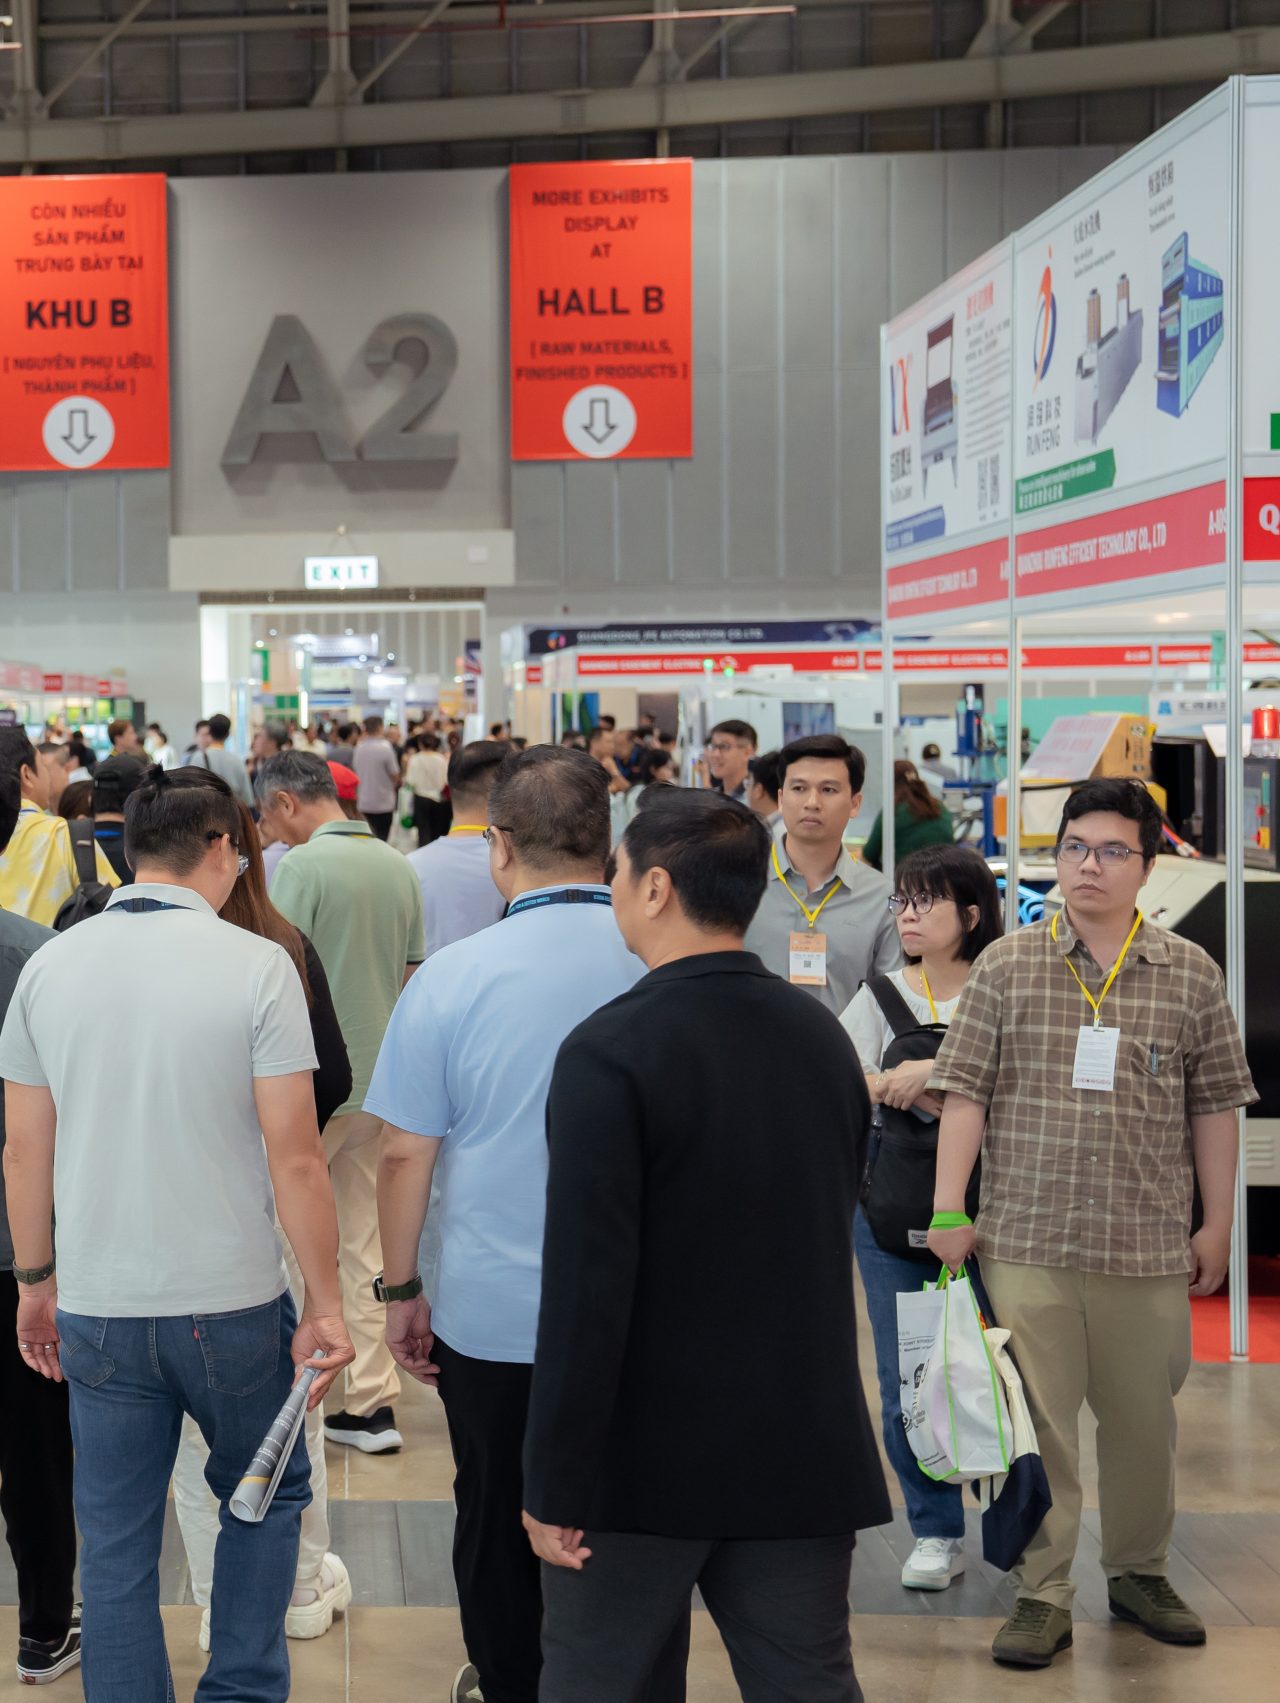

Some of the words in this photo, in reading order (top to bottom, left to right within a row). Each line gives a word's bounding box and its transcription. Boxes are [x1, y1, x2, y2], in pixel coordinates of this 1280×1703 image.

[533, 190, 583, 206] MORE
[589, 188, 669, 205] EXHIBITS
[31, 202, 66, 220] CÒN
[564, 217, 638, 233] DISPLAY
[590, 243, 612, 258] AT
[538, 288, 630, 317] HALL
[643, 285, 664, 314] B
[26, 299, 97, 329] KHU
[111, 299, 132, 328] B
[540, 341, 576, 356] RAW
[516, 366, 588, 381] FINISHED
[595, 364, 677, 379] PRODUCTS
[220, 312, 460, 482] A2
[1099, 529, 1138, 560] TECHNOLOGY
[1153, 522, 1167, 548] LTD
[311, 565, 371, 582] EXIT
